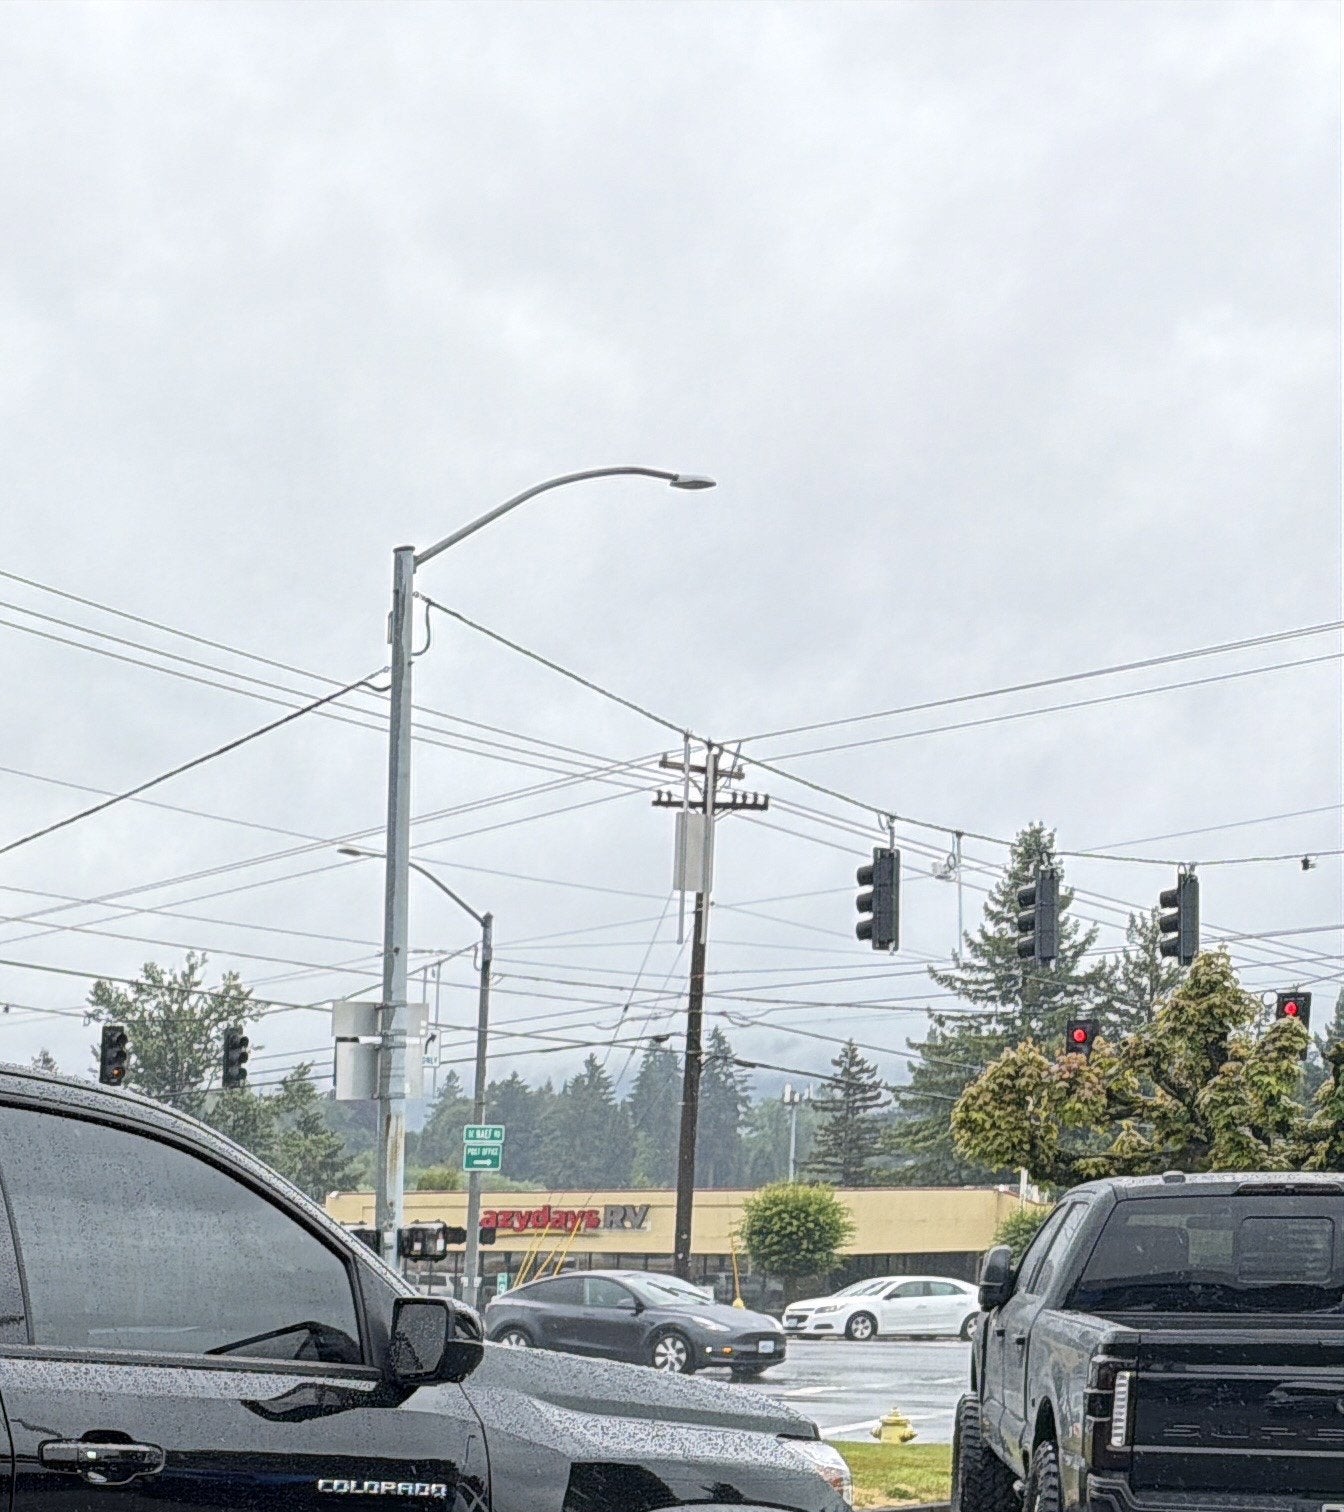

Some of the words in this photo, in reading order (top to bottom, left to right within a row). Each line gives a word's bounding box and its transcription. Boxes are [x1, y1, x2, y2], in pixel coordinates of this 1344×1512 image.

[467, 1147, 480, 1156] POST
[481, 1147, 499, 1156] OFFICE
[479, 1204, 602, 1232] azydays
[603, 1204, 651, 1230] RV
[317, 1478, 448, 1498] COLORADO
